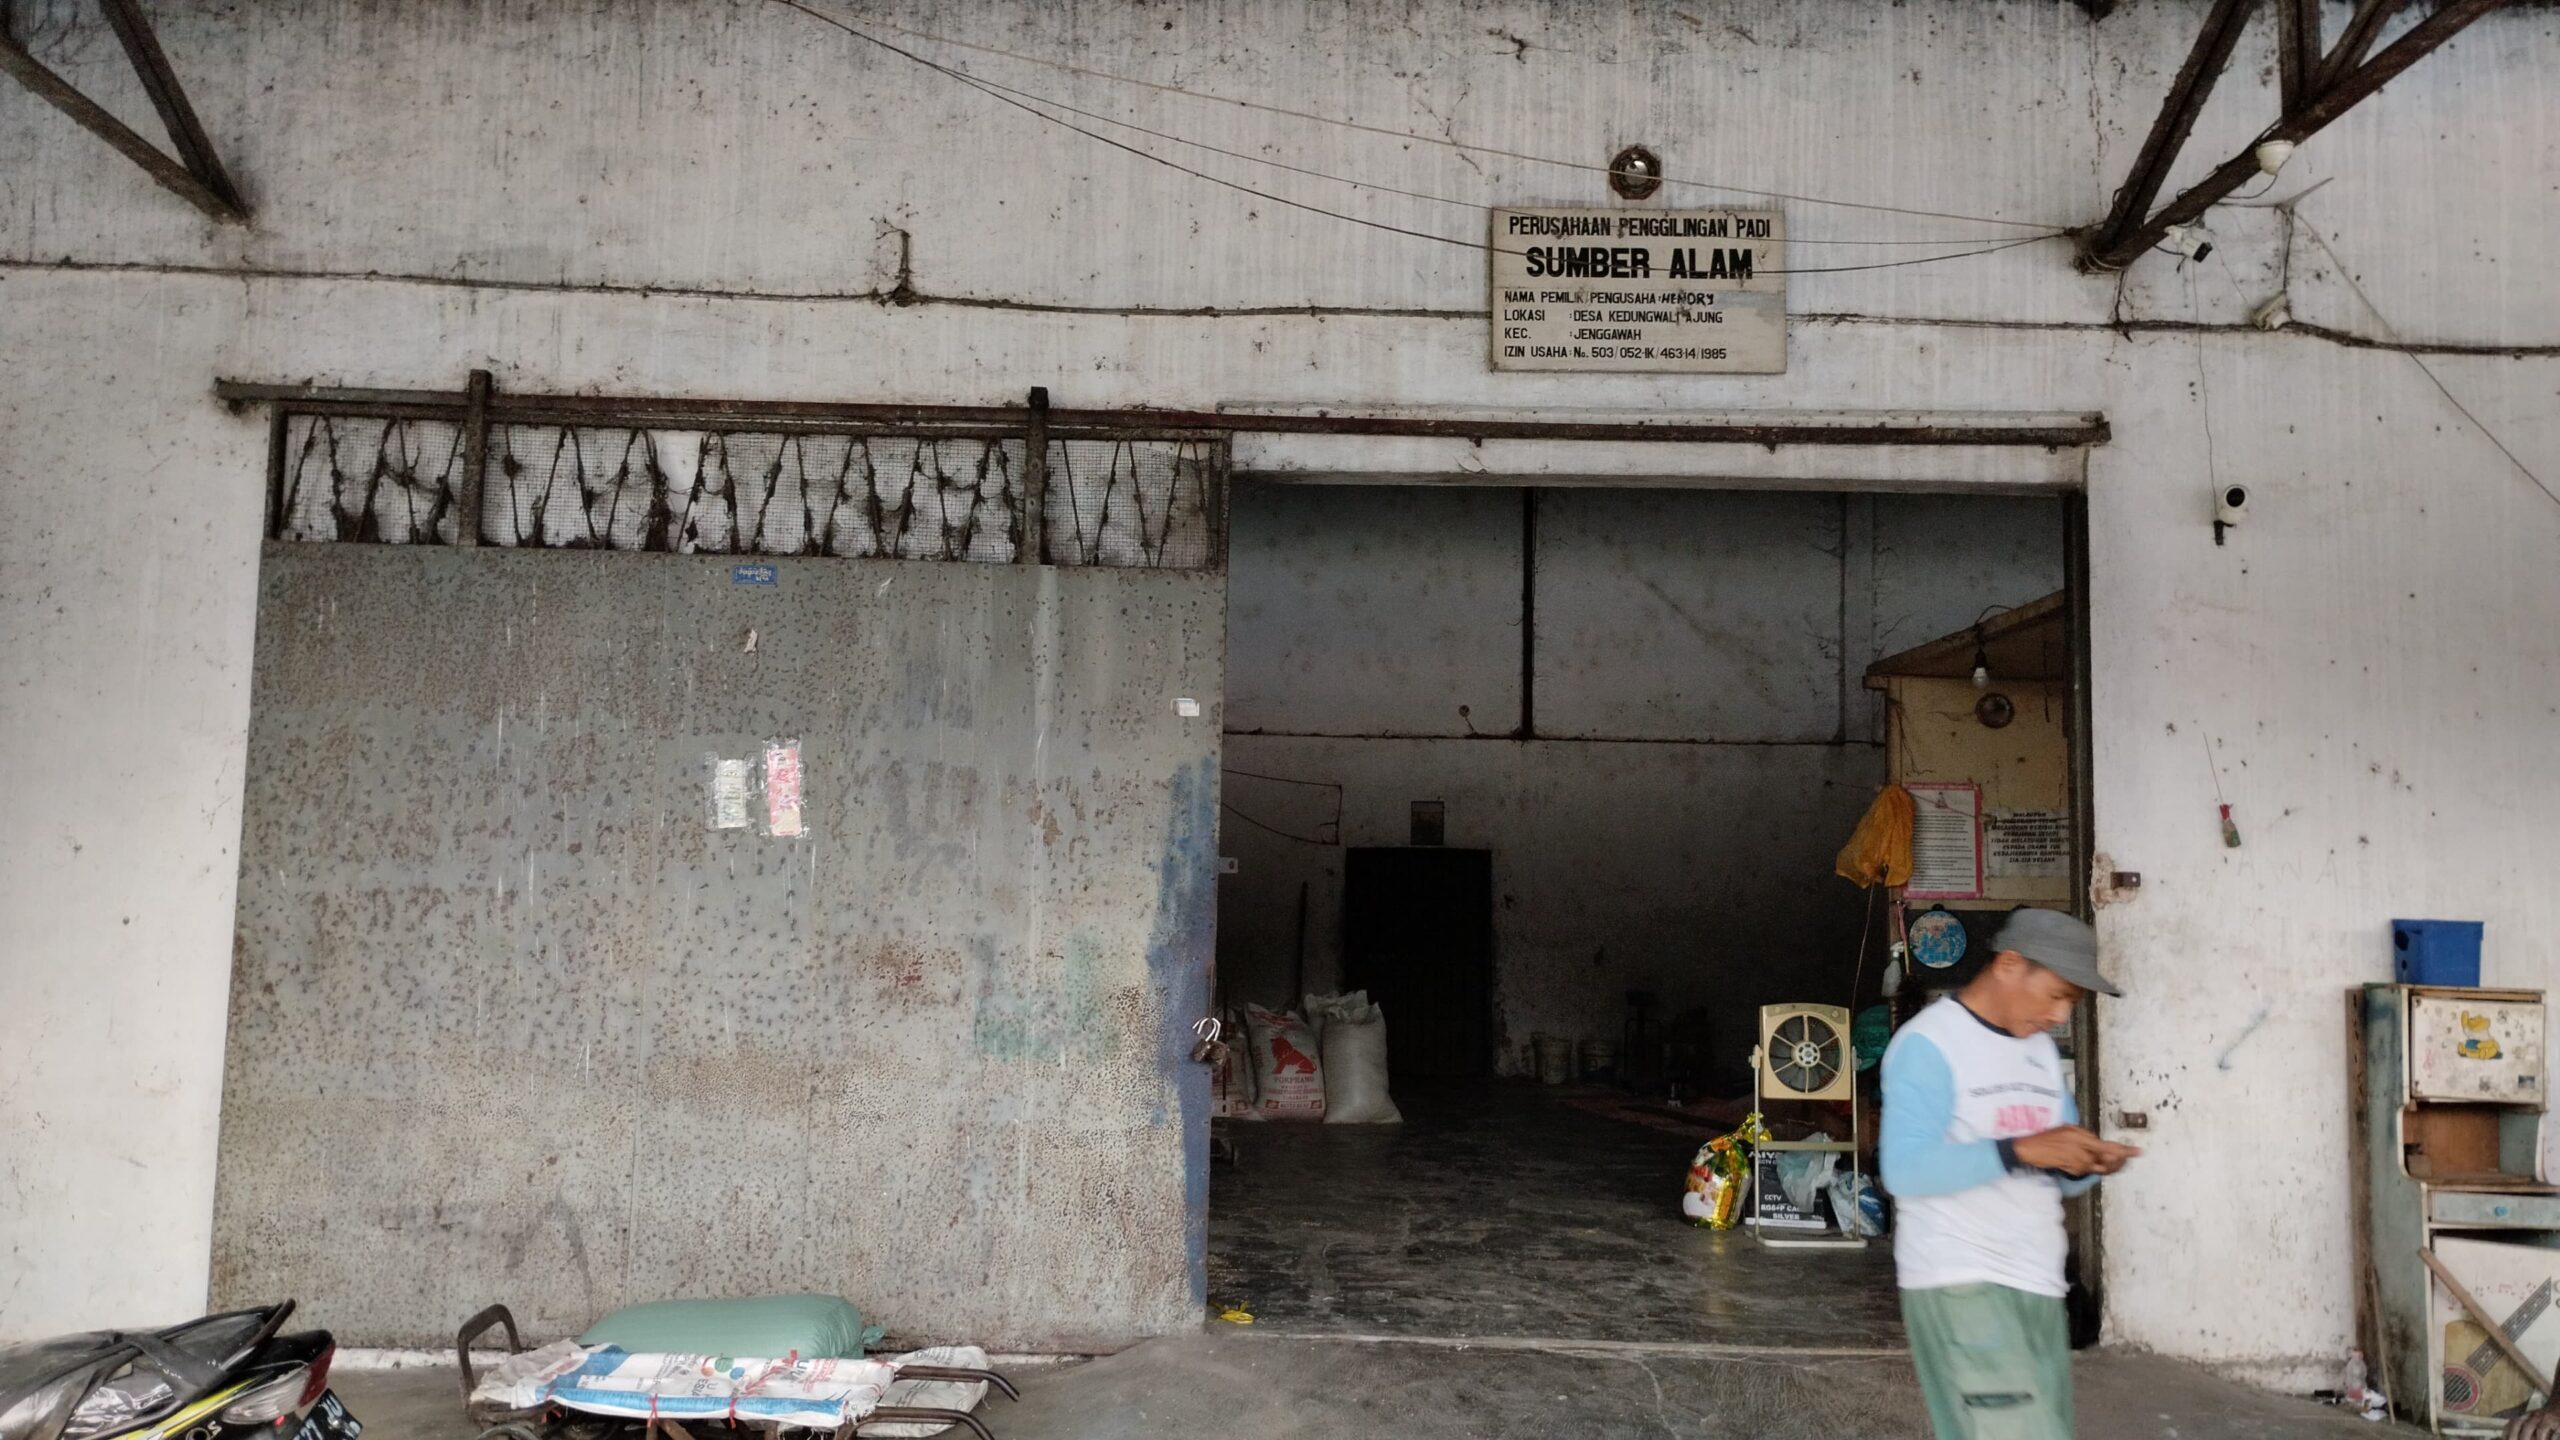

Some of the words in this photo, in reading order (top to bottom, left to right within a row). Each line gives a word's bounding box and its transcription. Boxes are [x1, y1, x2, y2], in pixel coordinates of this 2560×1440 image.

[1509, 216, 1611, 236] PERUSAHAAN
[1617, 217, 1727, 238] PENGGILINGAN
[1736, 219, 1771, 238] PADI
[1526, 246, 1650, 278] SUMBER
[1669, 248, 1753, 279] ALAM
[1504, 291, 1535, 303] NAMA
[1504, 309, 1545, 321] LOKASI
[1504, 327, 1532, 339] KEC.
[1504, 346, 1525, 357] IZIN
[1531, 346, 1567, 357] USAHA
